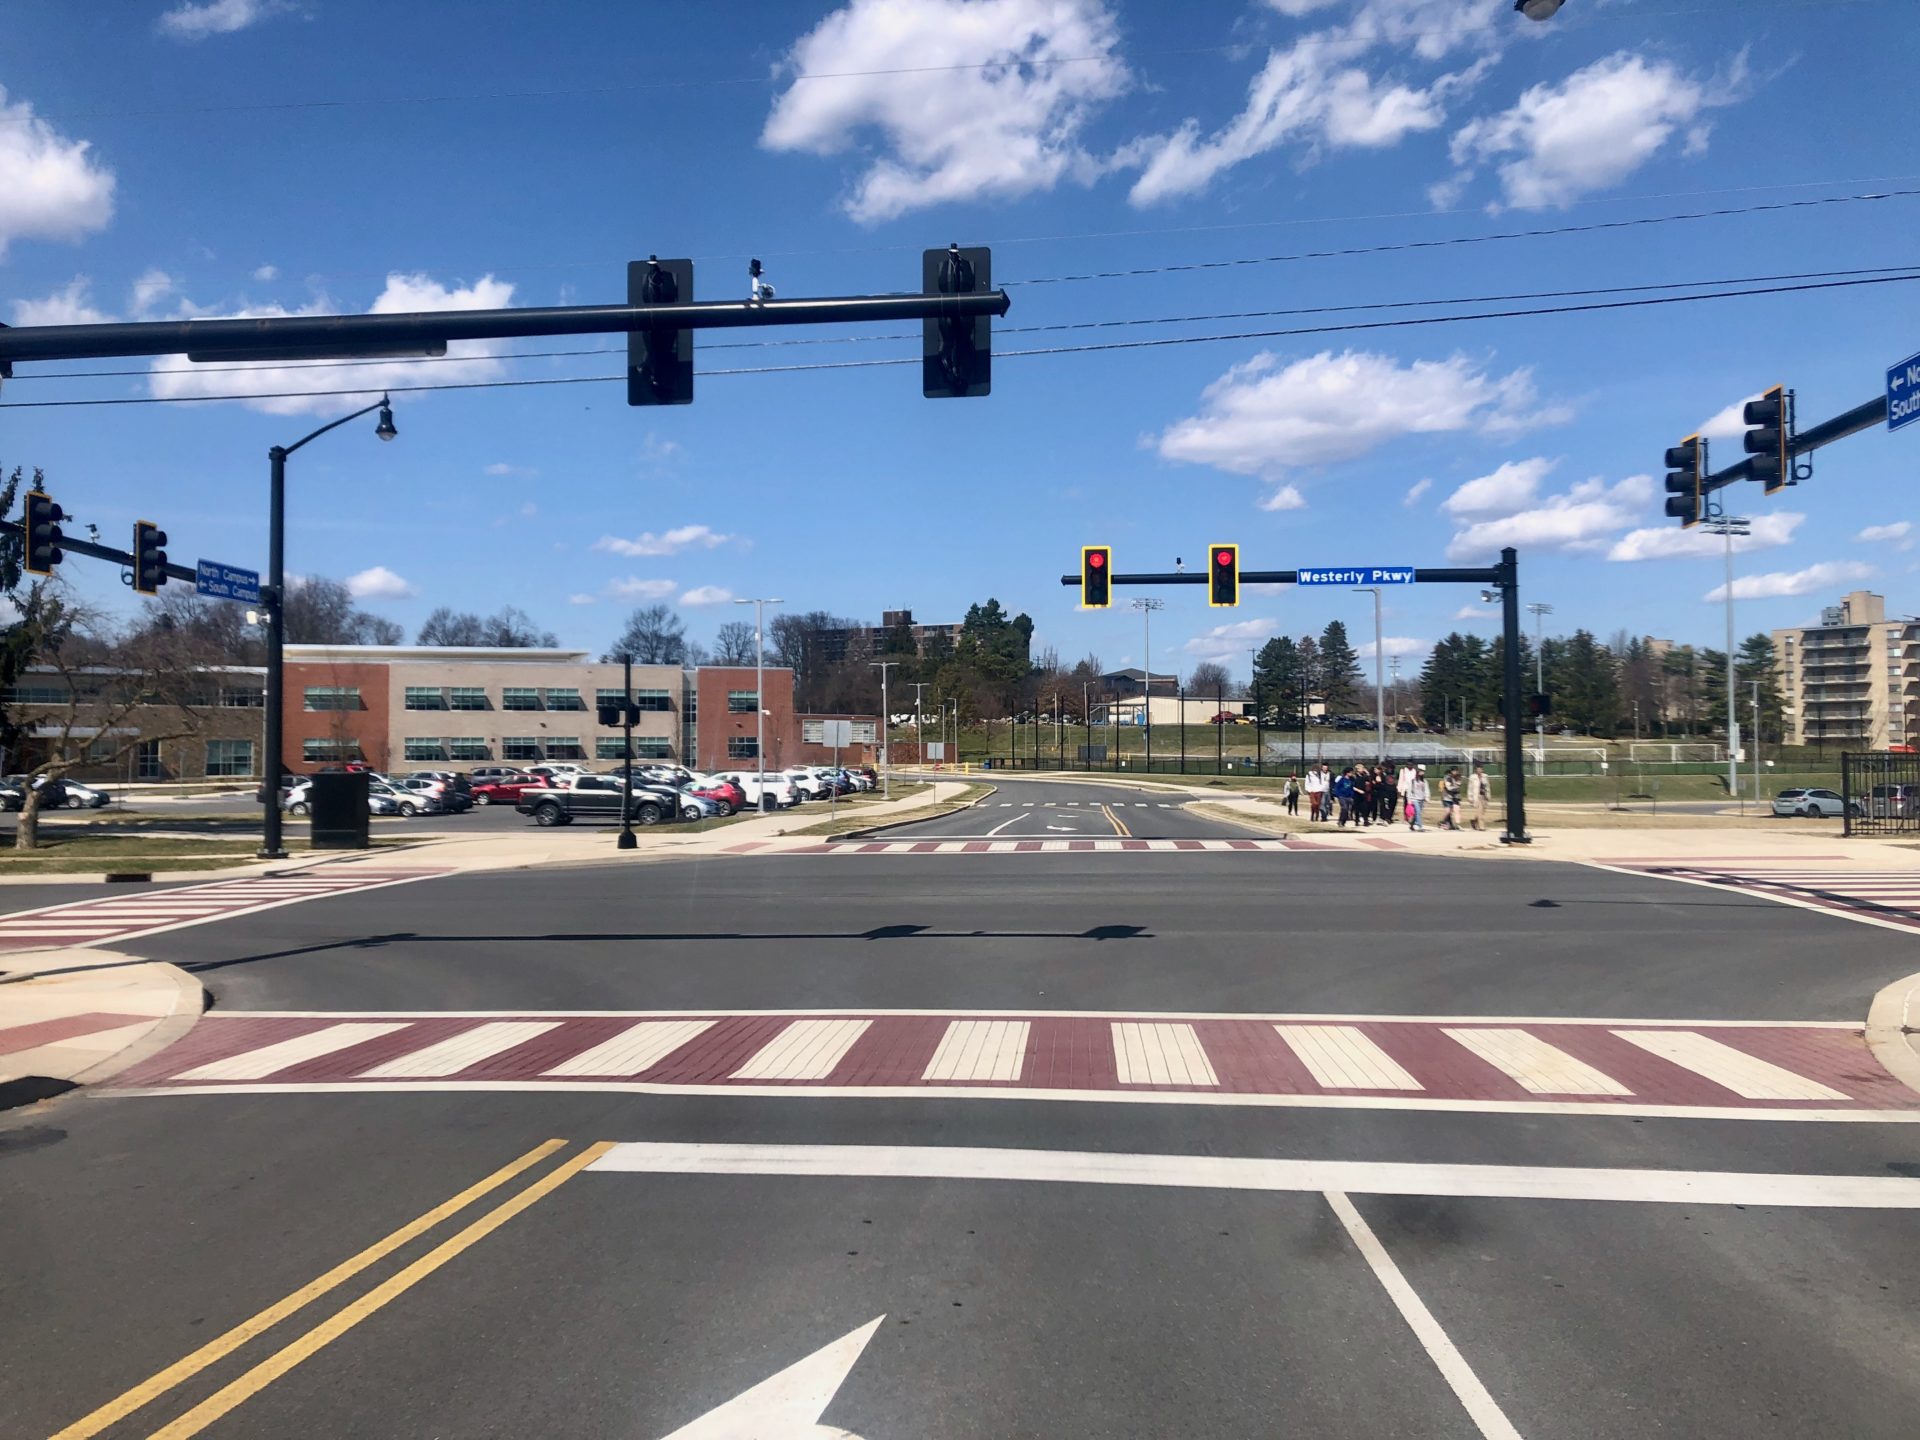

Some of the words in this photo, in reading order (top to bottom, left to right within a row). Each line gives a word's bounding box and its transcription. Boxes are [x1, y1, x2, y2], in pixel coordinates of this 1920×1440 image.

[200, 562, 219, 579] North
[223, 569, 248, 585] Campus
[1300, 571, 1364, 584] Westerly
[1372, 570, 1412, 584] Pkwy
[208, 580, 229, 595] South
[232, 585, 257, 601] Campus
